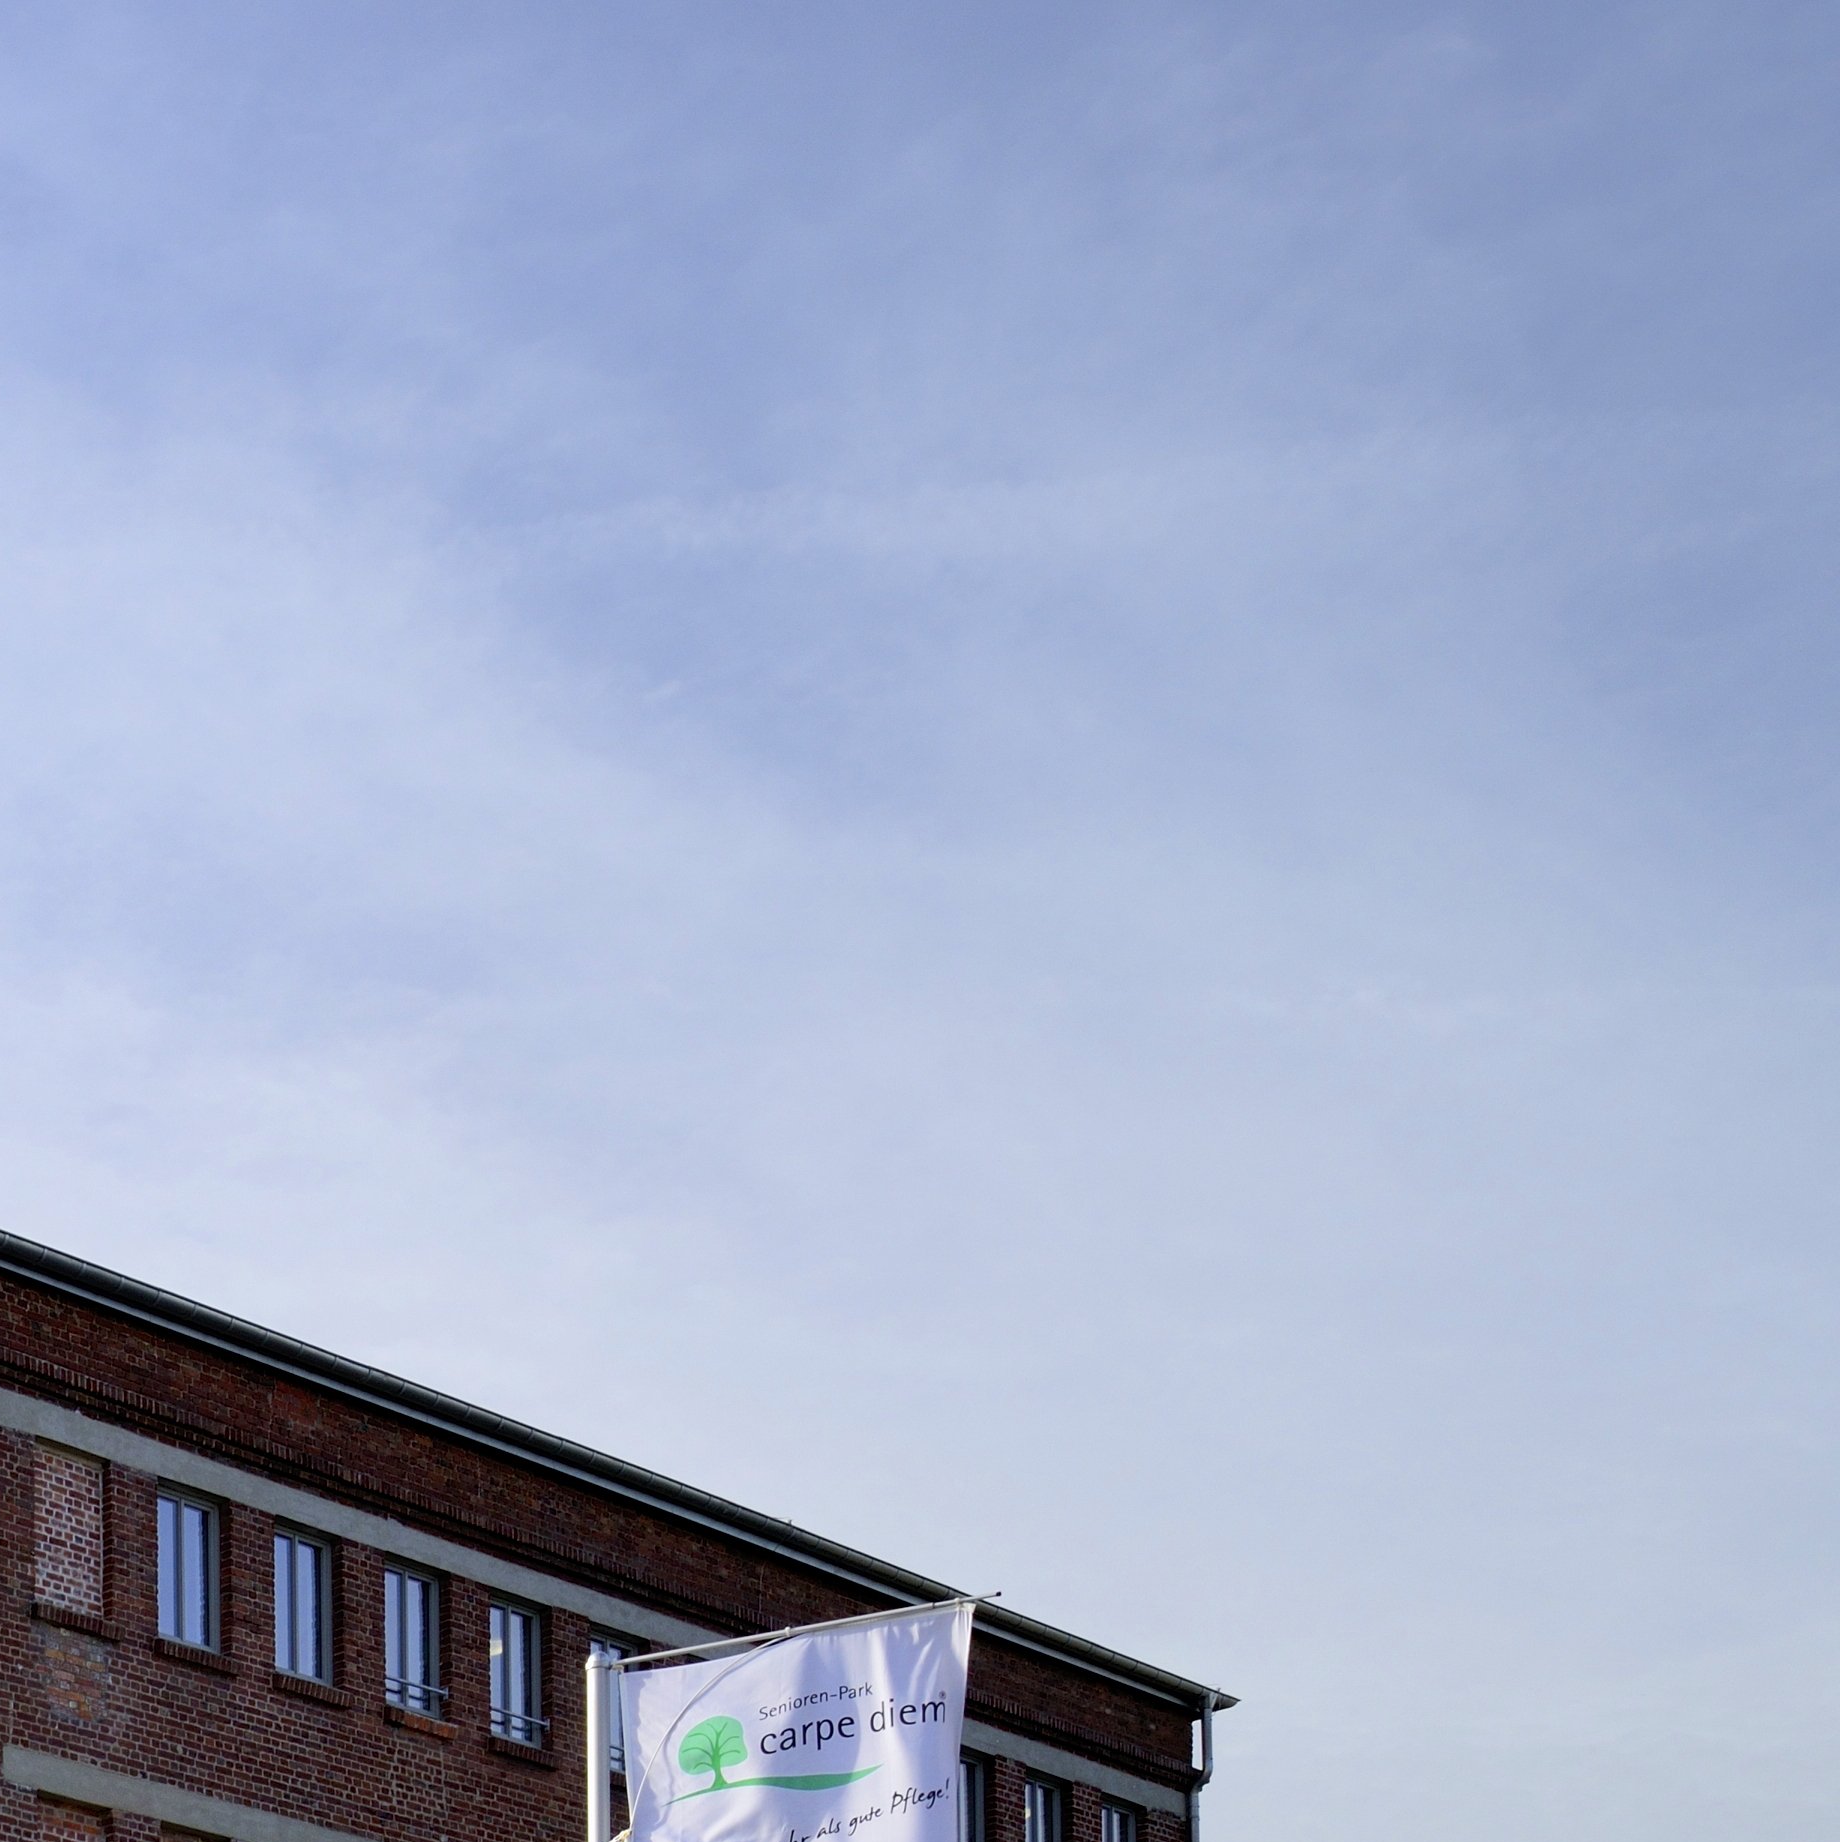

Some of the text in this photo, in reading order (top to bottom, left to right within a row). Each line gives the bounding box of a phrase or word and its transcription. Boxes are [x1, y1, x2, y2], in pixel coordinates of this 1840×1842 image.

[758, 1682, 873, 1721] Senioren-Park
[760, 1715, 855, 1755] carpe
[817, 1817, 841, 1839] als
[848, 1806, 884, 1836] gute
[890, 1778, 950, 1814] Pflege!
